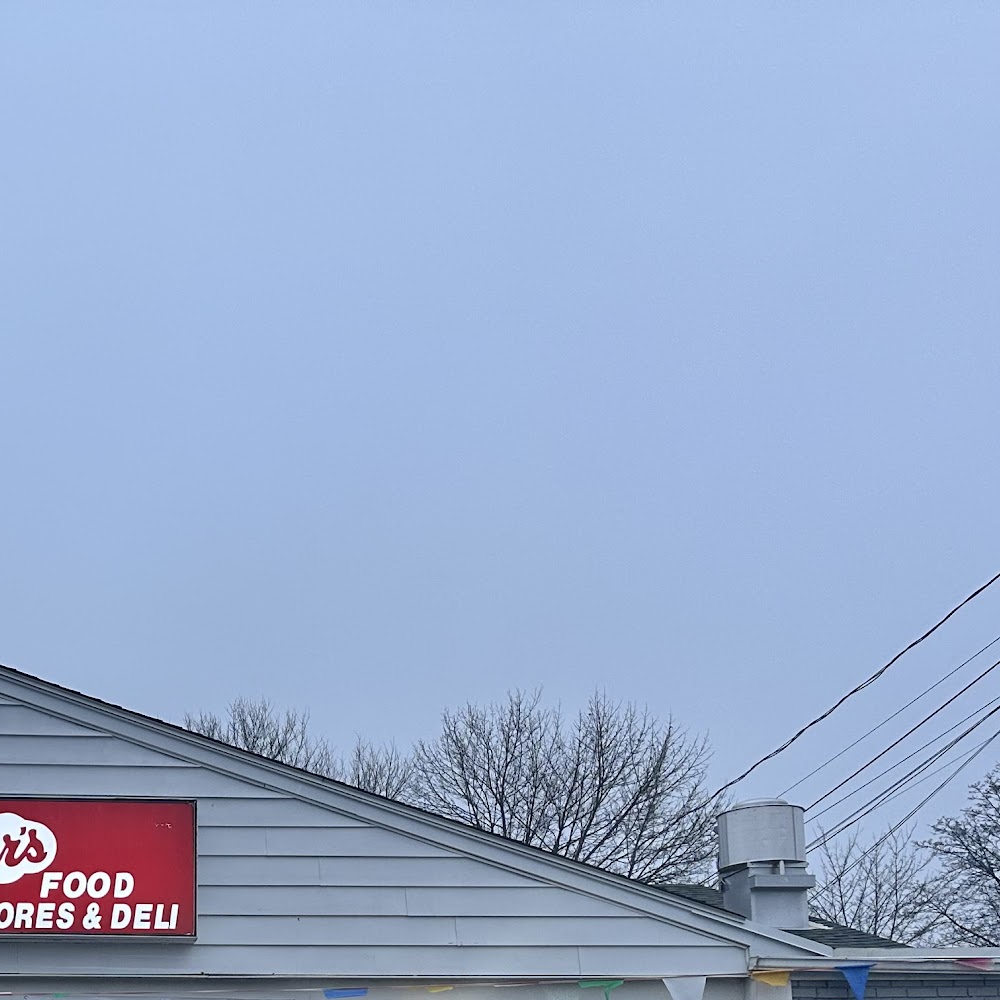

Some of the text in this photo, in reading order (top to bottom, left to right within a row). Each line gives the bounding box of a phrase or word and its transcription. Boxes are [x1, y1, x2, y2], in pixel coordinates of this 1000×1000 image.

[40, 871, 135, 899] FOOD
[82, 903, 102, 930] &
[110, 903, 179, 930] DELI
